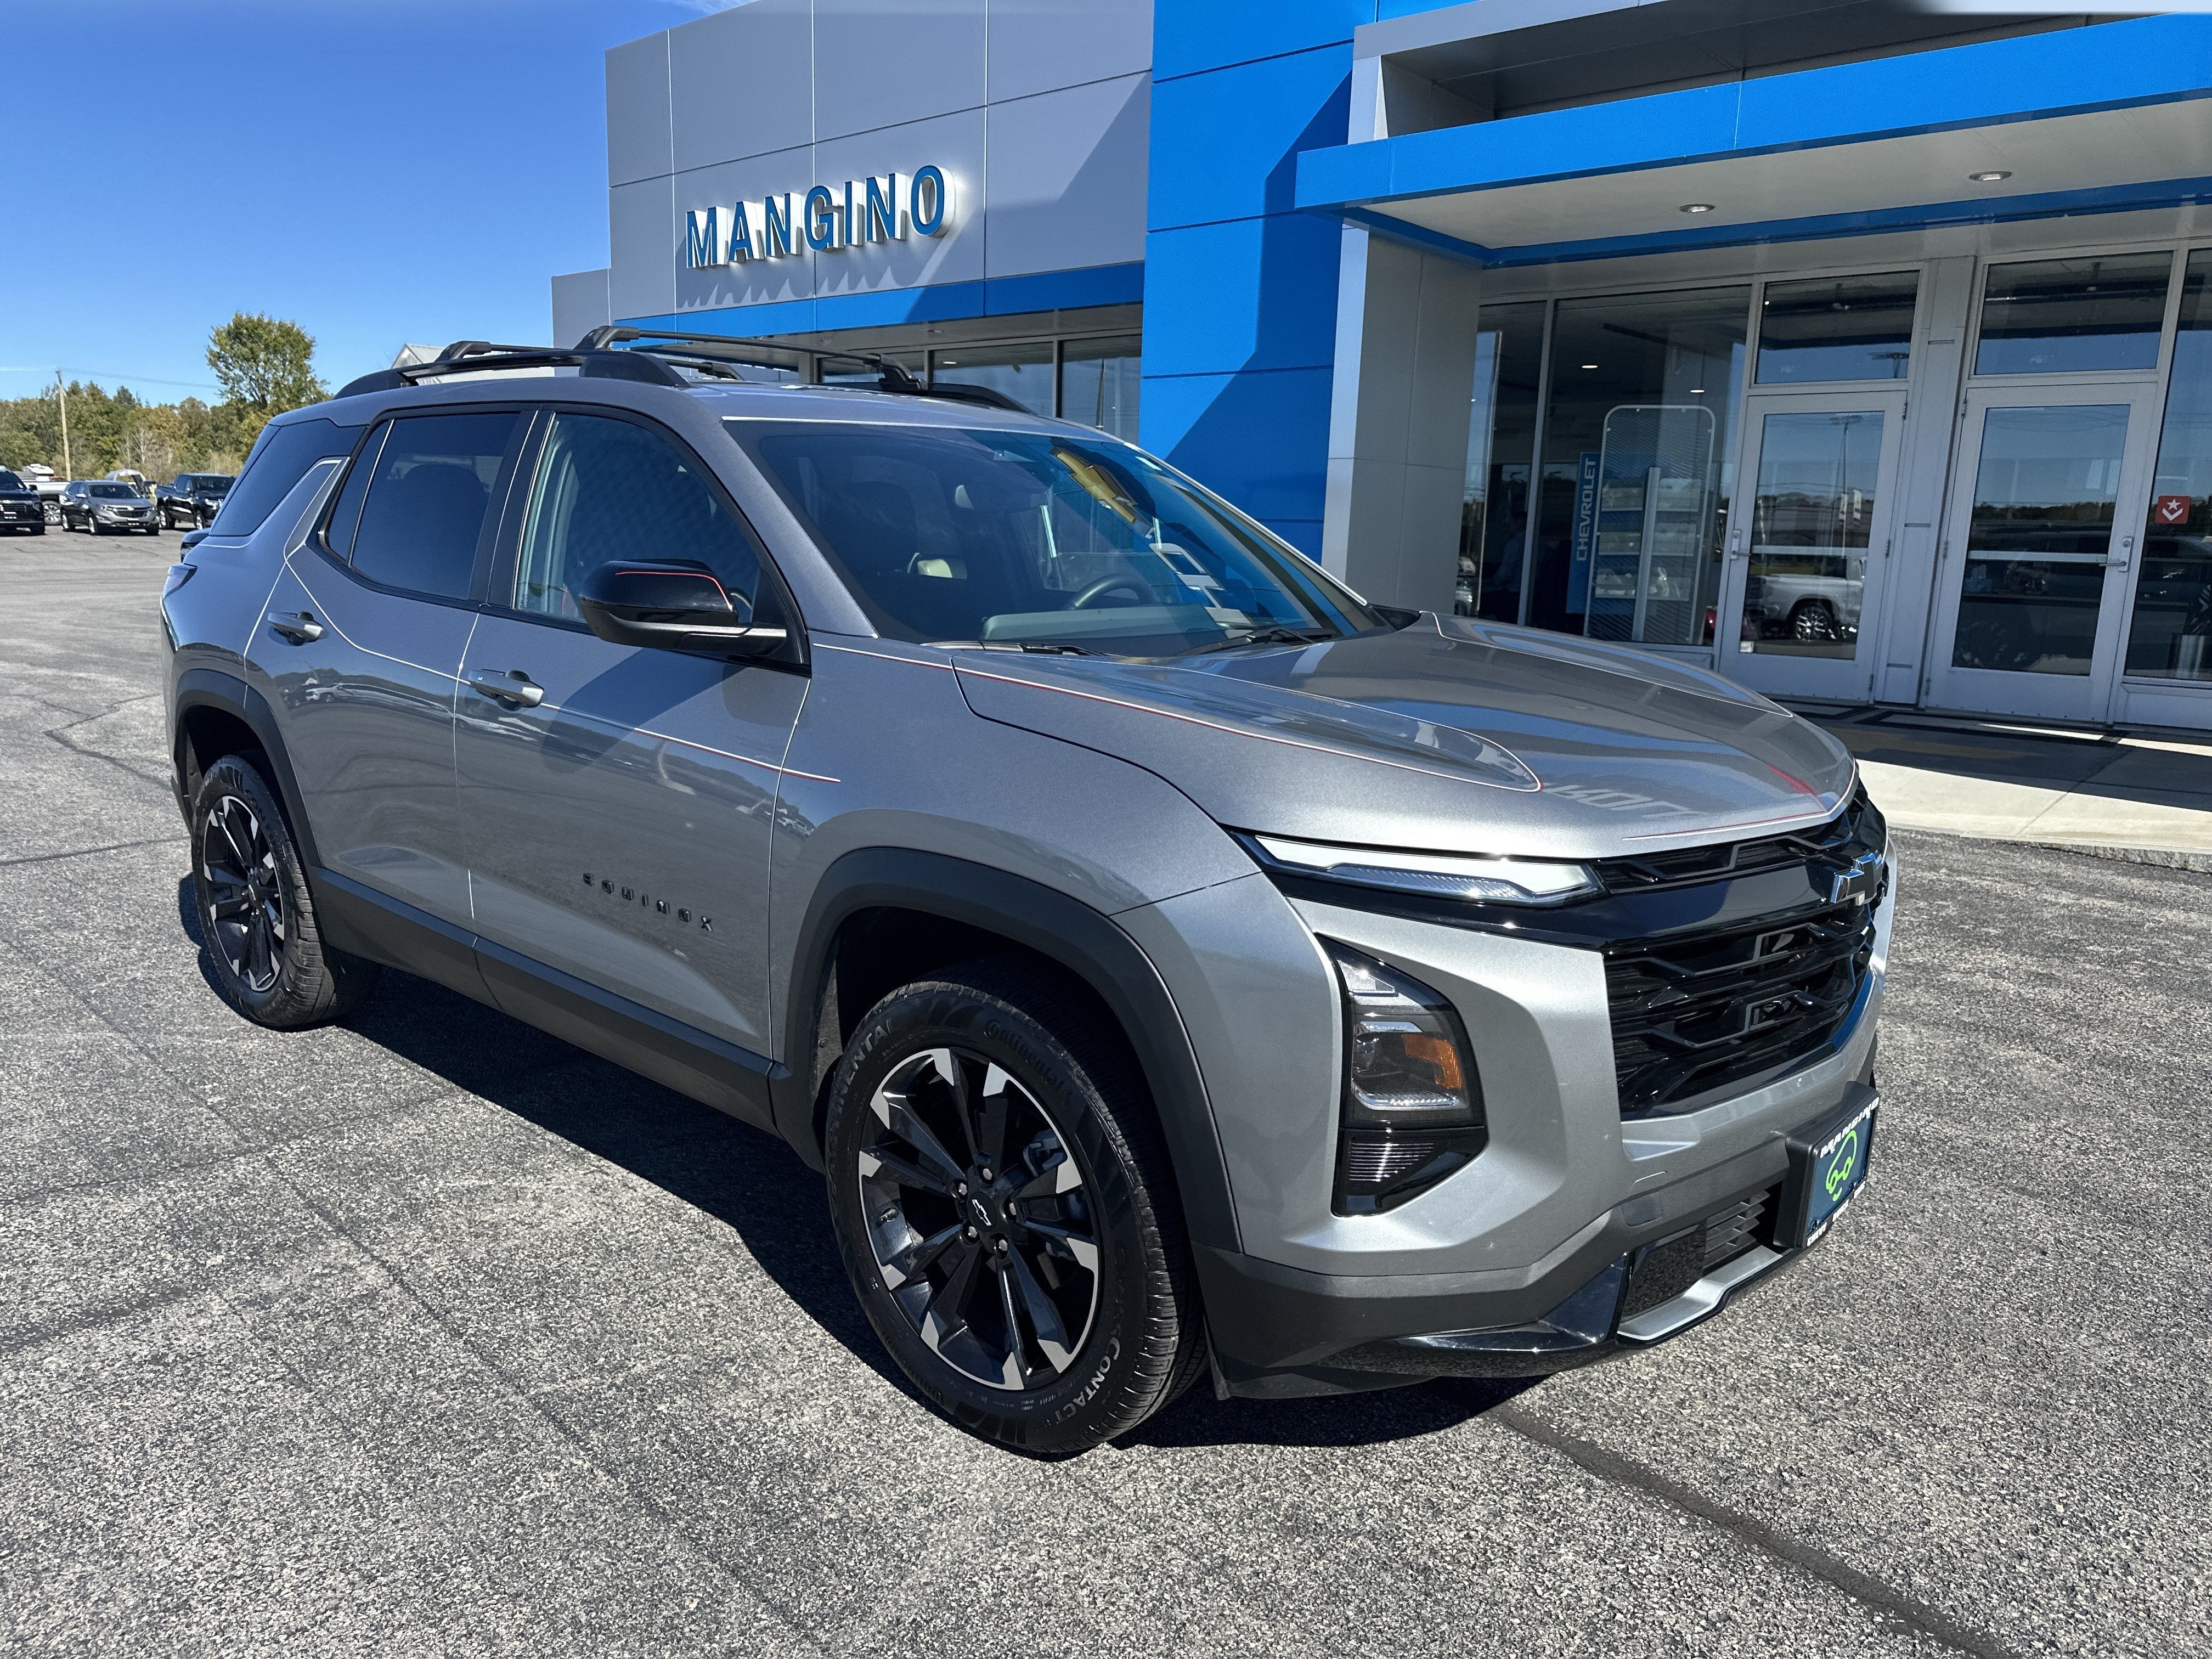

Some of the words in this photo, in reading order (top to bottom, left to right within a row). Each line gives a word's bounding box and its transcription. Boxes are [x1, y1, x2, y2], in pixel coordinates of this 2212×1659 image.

[686, 165, 955, 269] MANGINO
[1576, 458, 1596, 562] CHEVROLET
[583, 873, 713, 933] EQUINOX
[1820, 1097, 1880, 1159] MANGINO
